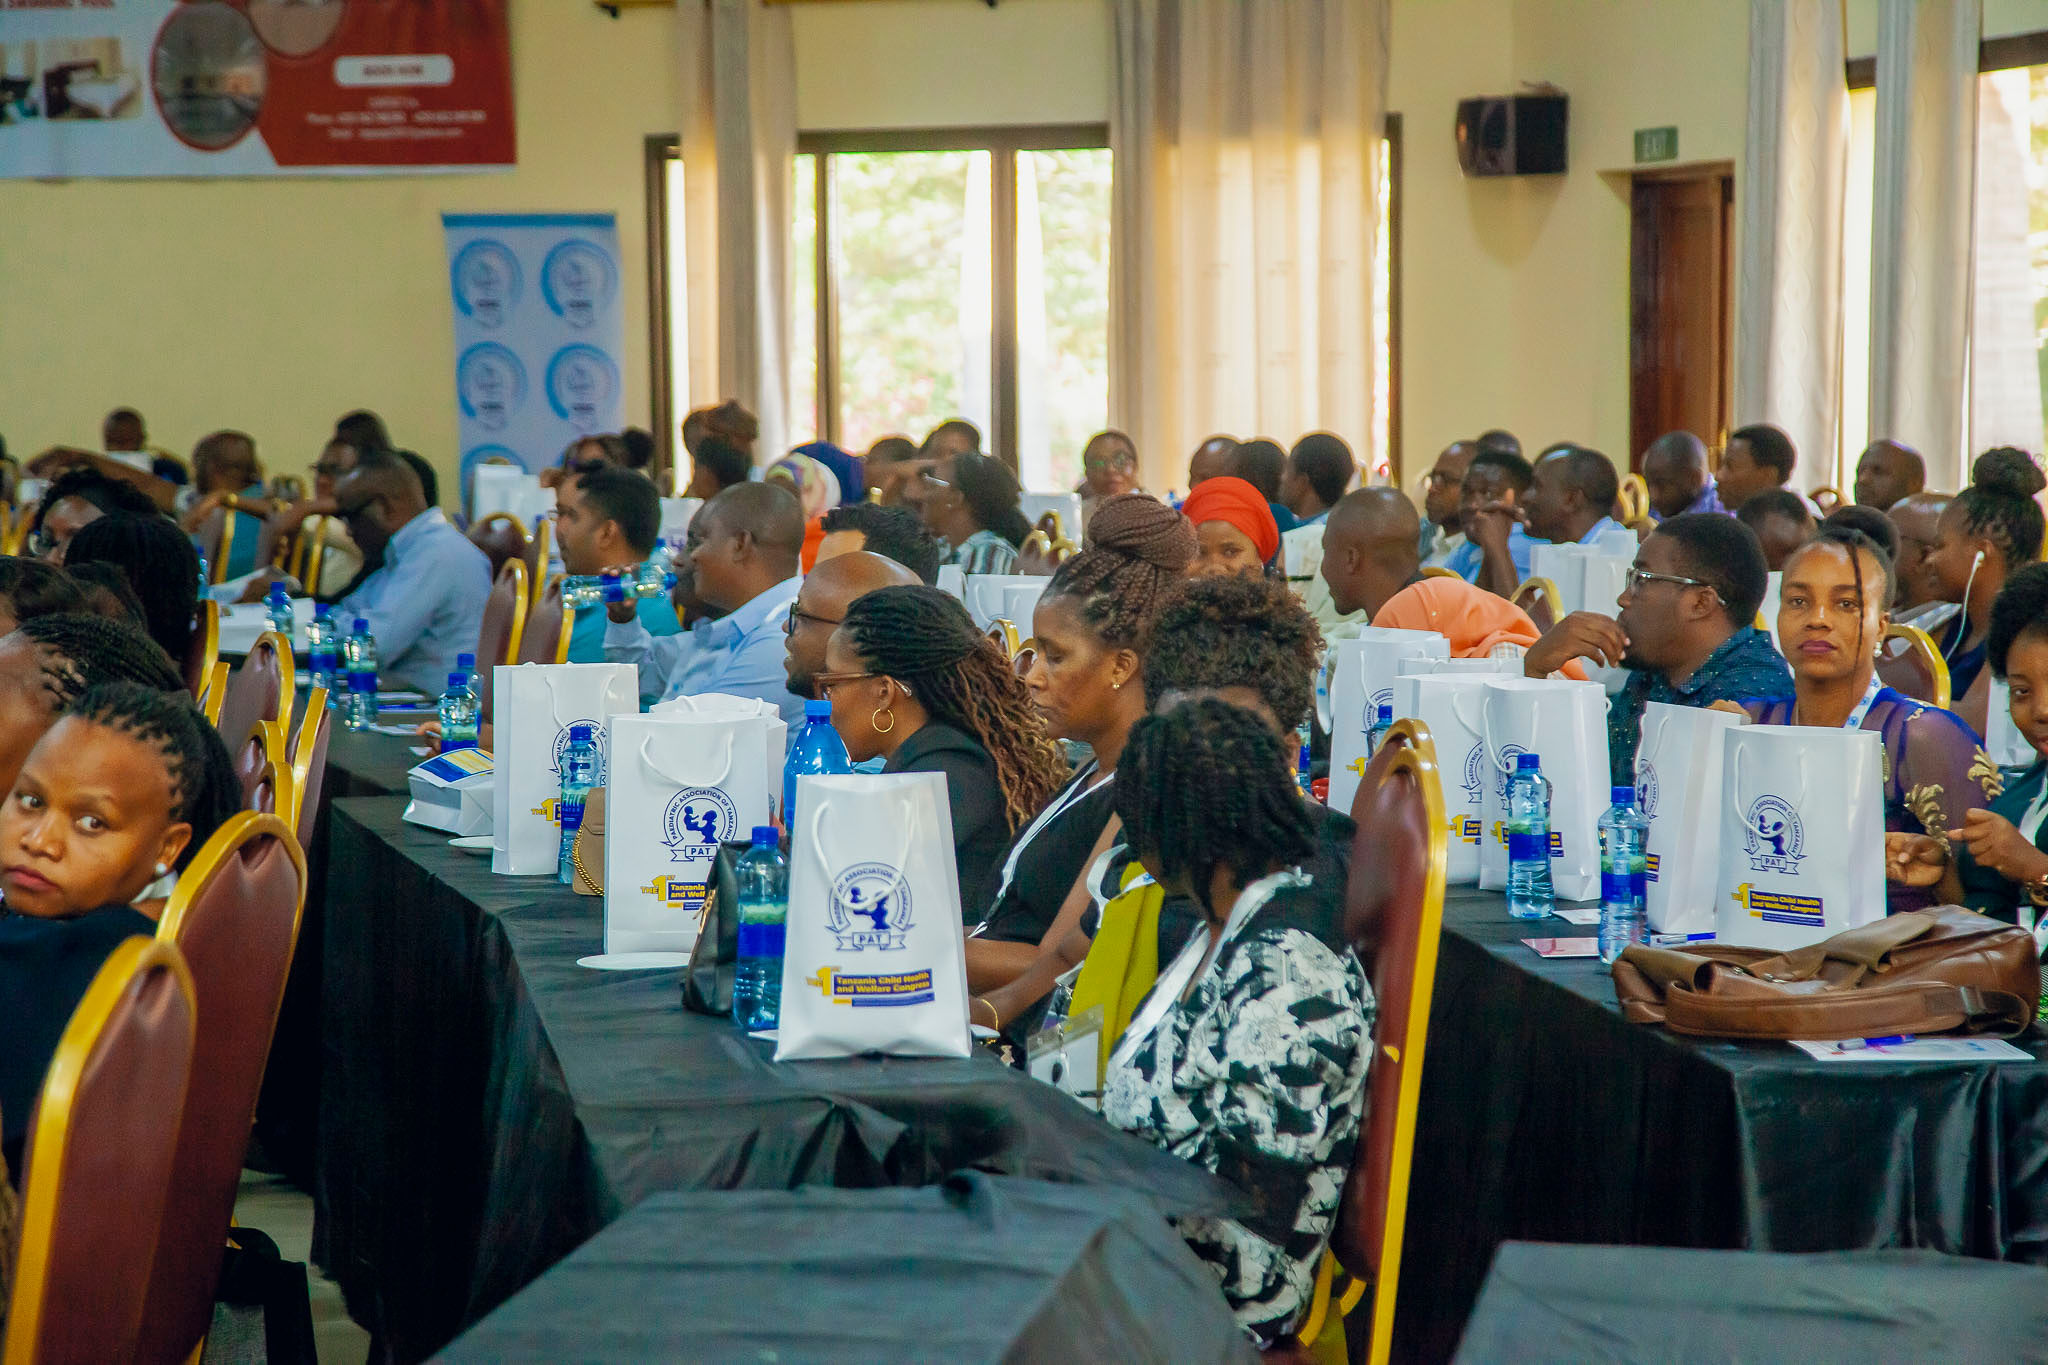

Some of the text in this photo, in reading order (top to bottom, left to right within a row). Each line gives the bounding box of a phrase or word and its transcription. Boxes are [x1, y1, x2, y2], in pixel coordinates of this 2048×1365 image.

[1469, 751, 1479, 784] PAEDIATRIC
[669, 790, 734, 840] PAEDIATRIC ASSOCIATION OF TANZANIA
[1791, 821, 1800, 853] TANZANIA
[1766, 858, 1781, 866] PAT
[640, 886, 659, 894] THE
[1751, 892, 1778, 902] Tanzania
[1764, 902, 1789, 910] Welfare
[1790, 905, 1821, 913] Congress
[859, 935, 882, 943] PAT
[836, 972, 930, 985] Tanzania Child Health
[836, 981, 930, 993] and Welfare Congress
